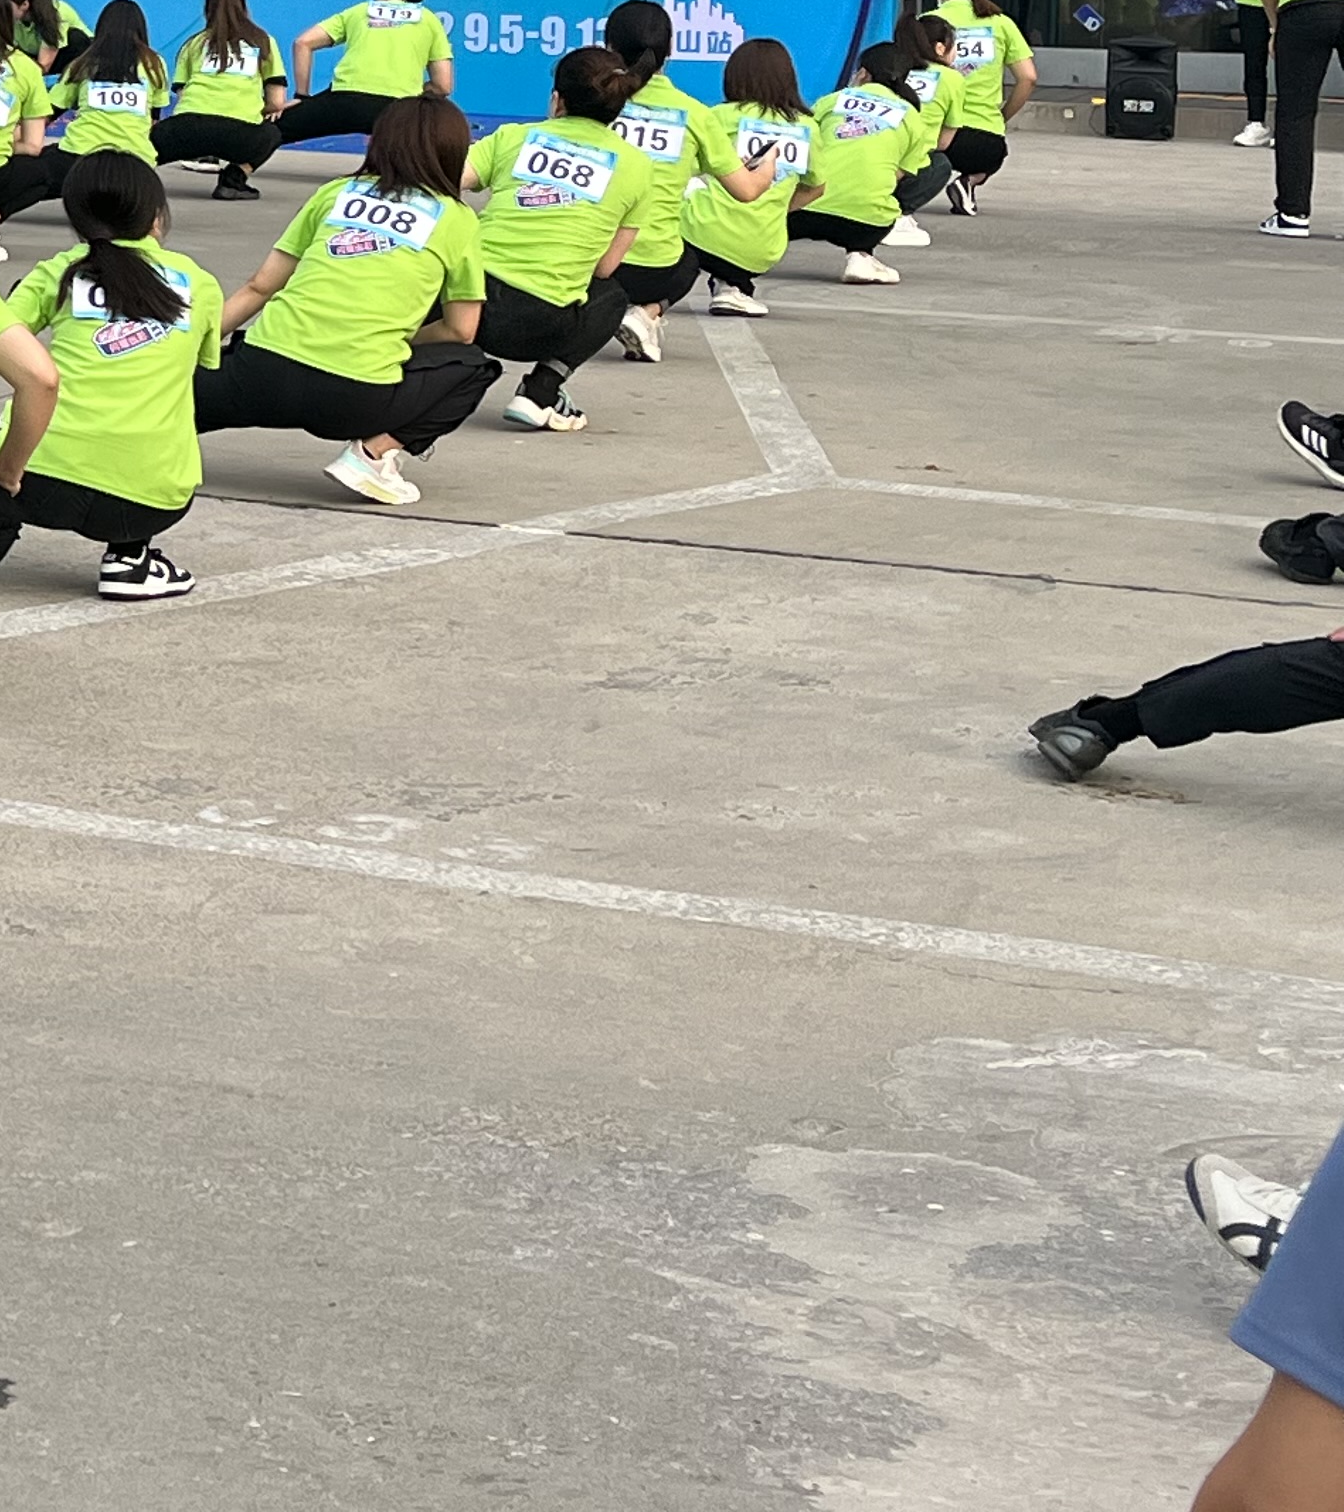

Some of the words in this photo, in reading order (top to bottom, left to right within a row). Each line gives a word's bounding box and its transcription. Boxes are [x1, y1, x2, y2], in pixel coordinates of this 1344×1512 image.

[675, 29, 733, 55] 山站
[956, 41, 985, 58] 54
[96, 90, 139, 108] 109
[843, 97, 893, 117] 097
[747, 136, 798, 163] 00
[527, 150, 595, 188] 068
[343, 198, 418, 235] 008
